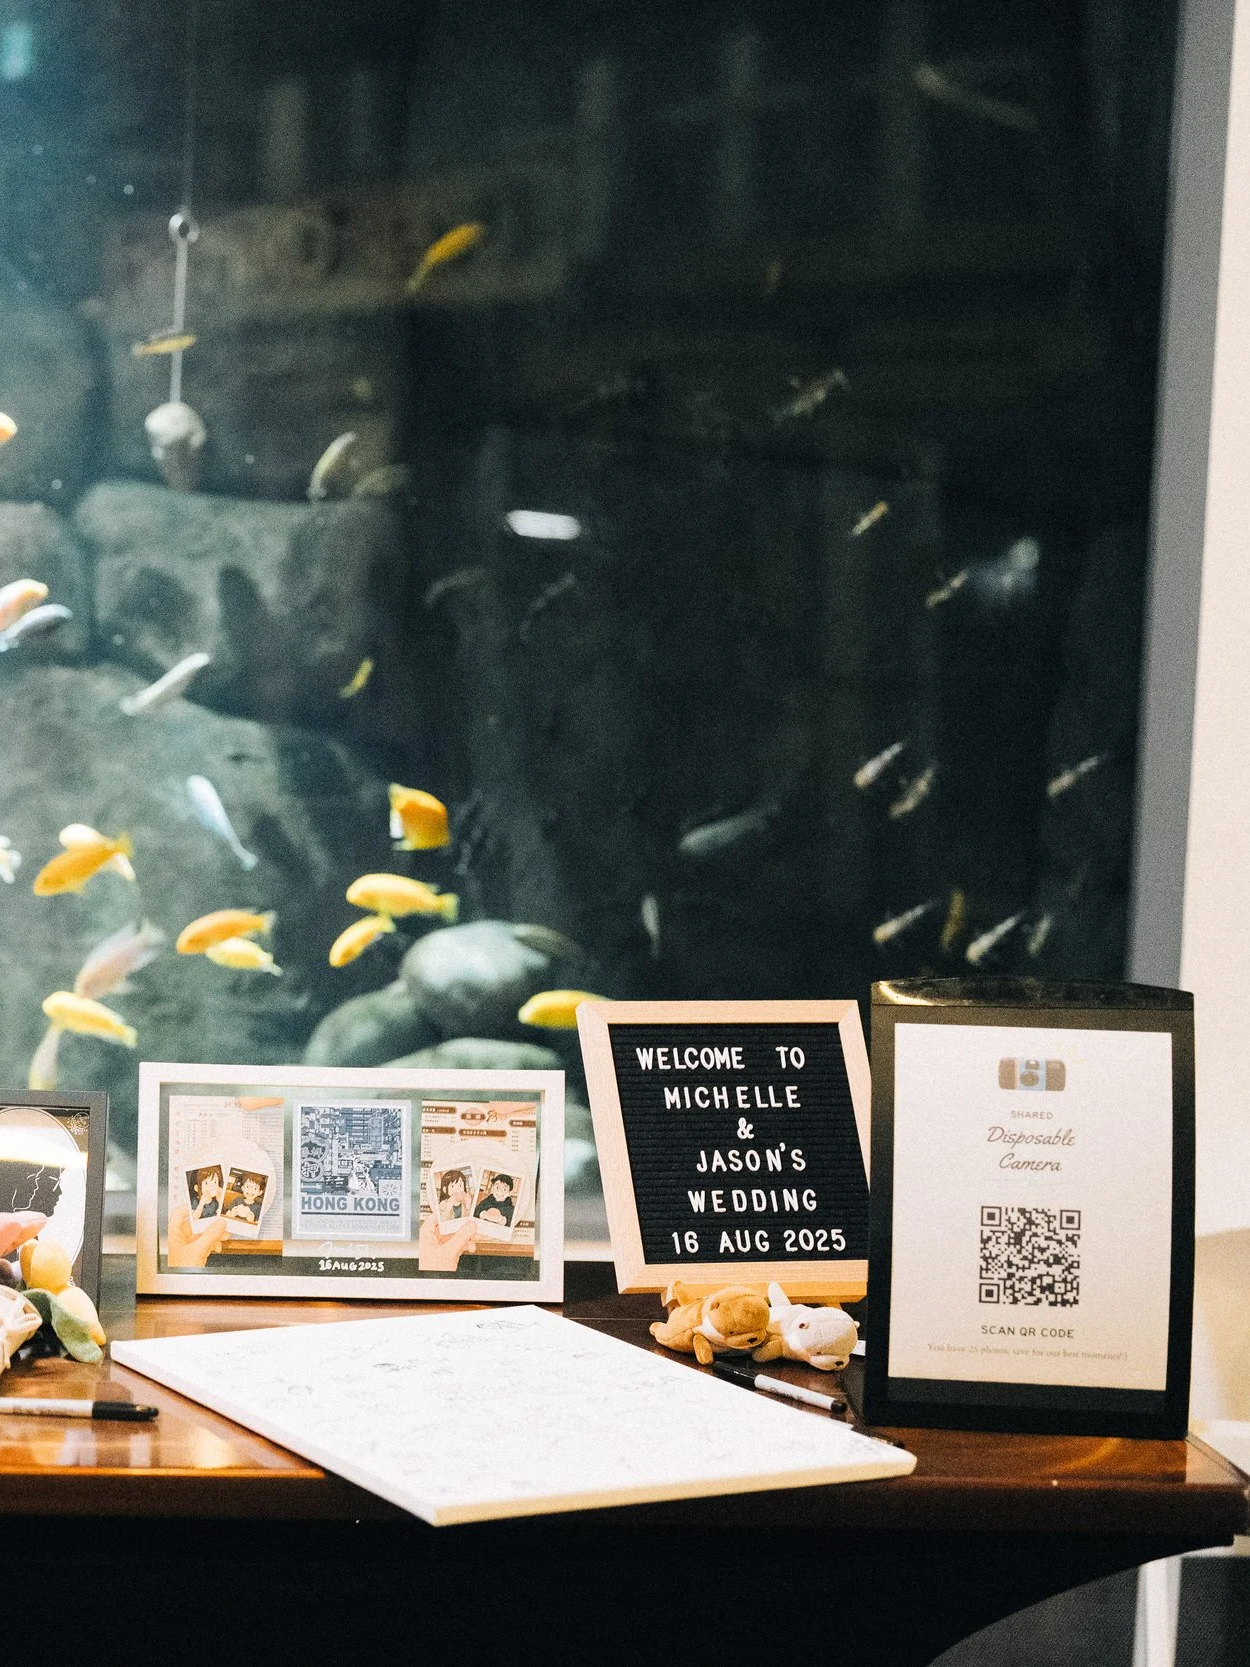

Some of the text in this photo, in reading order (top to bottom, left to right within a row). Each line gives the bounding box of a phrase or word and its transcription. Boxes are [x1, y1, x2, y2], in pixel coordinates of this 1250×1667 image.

[636, 1046, 805, 1070] WELCOME TO
[664, 1086, 801, 1109] MICHELLE
[1011, 1110, 1053, 1120] SHARED
[737, 1117, 755, 1139] &
[988, 1126, 1075, 1149] Disposable
[696, 1142, 806, 1173] JASON'S
[999, 1153, 1061, 1171] Camera
[301, 1196, 400, 1211] HONG KONG
[687, 1189, 817, 1213] WEDDING
[671, 1229, 846, 1254] 16 AUG 2025
[981, 1325, 1074, 1338] SCAN QR CODE
[928, 1344, 944, 1352] You
[947, 1344, 965, 1352] have
[1032, 1348, 1044, 1357] for
[1063, 1349, 1079, 1358] best
